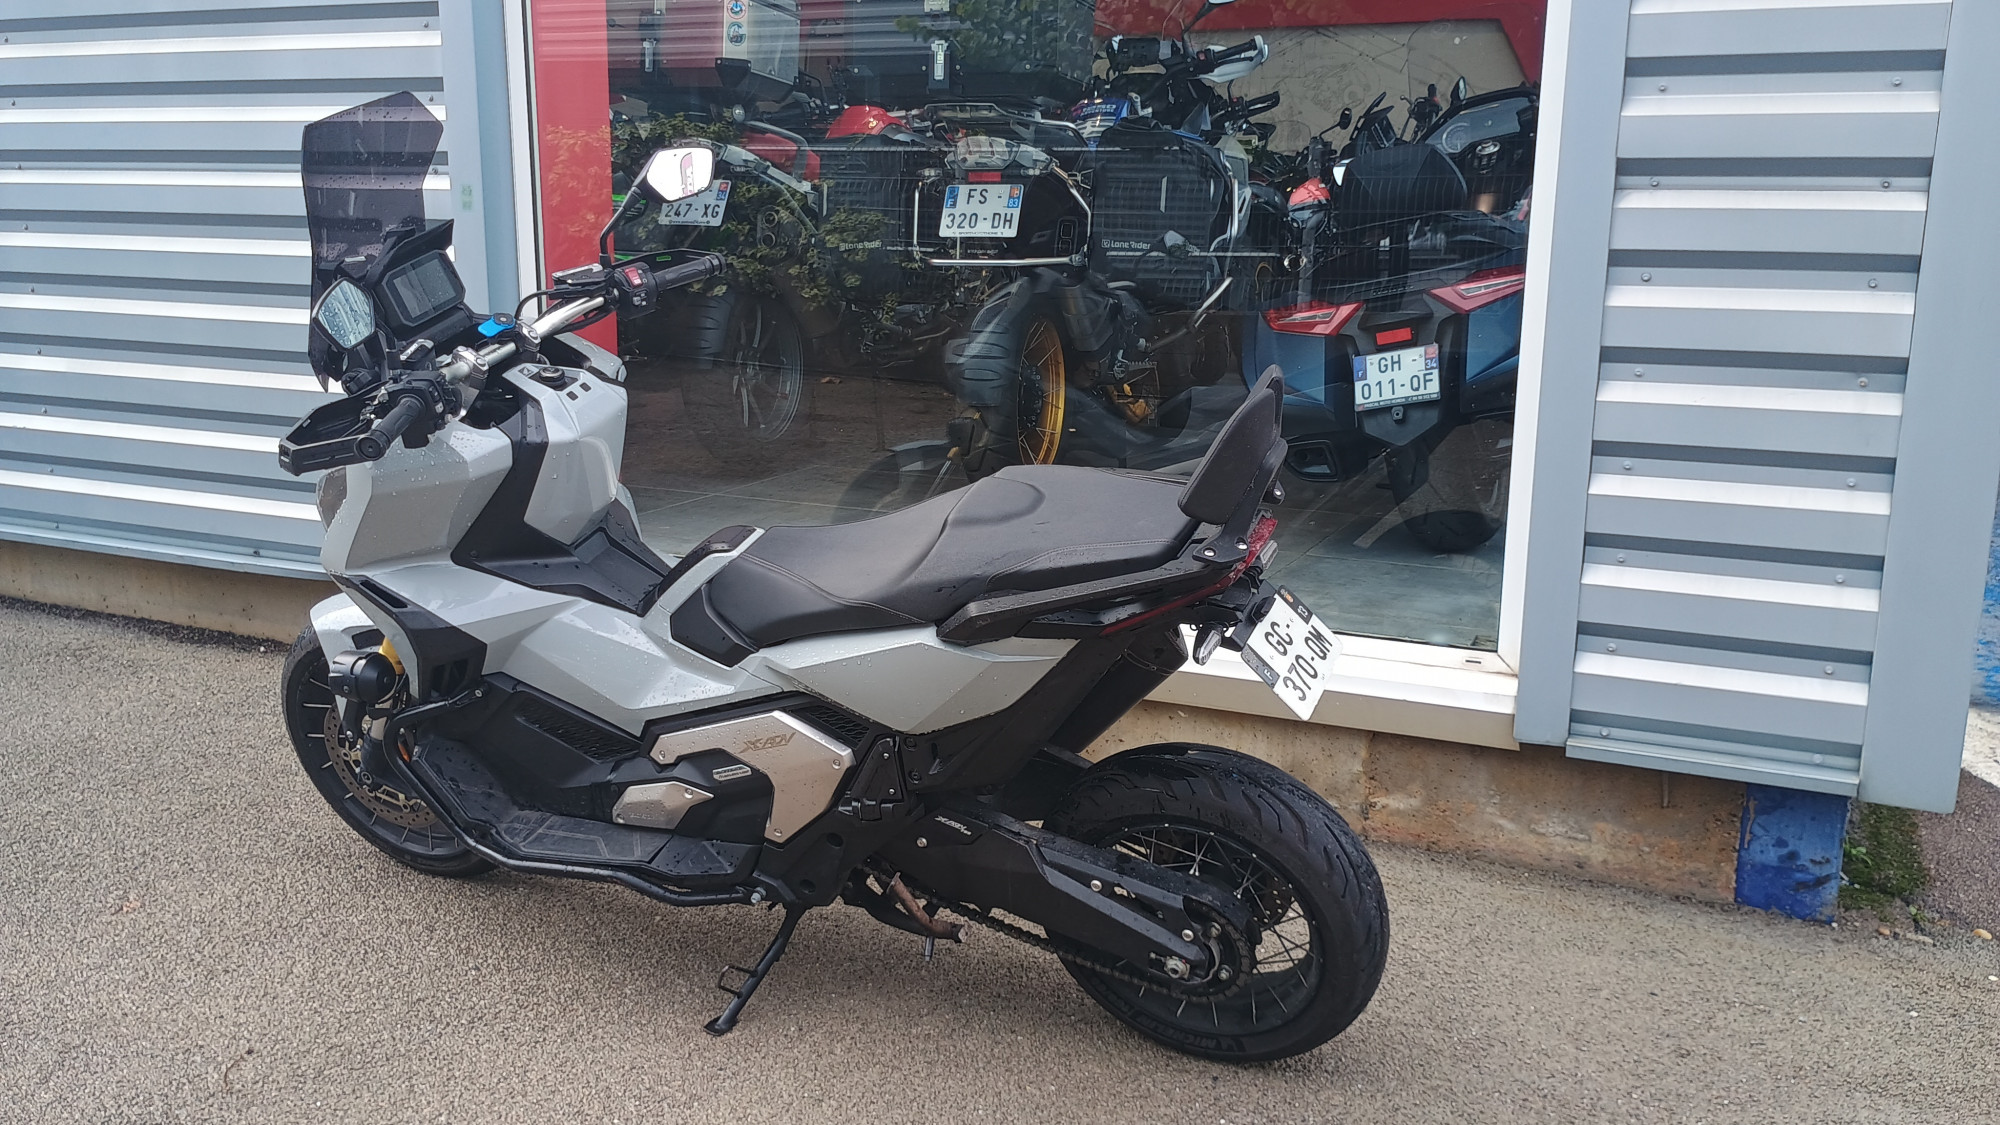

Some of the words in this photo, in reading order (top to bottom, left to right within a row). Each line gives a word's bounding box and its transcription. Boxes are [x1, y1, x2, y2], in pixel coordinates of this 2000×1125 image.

[717, 191, 726, 200] 34
[1008, 198, 1019, 207] 83
[664, 203, 720, 218] 247-XG
[945, 212, 1014, 230] 320-DH
[1425, 359, 1437, 368] 34
[1358, 370, 1364, 378] F
[1361, 372, 1434, 400] 011-QF
[1282, 624, 1333, 702] 370-QM
[1263, 669, 1273, 680] F
